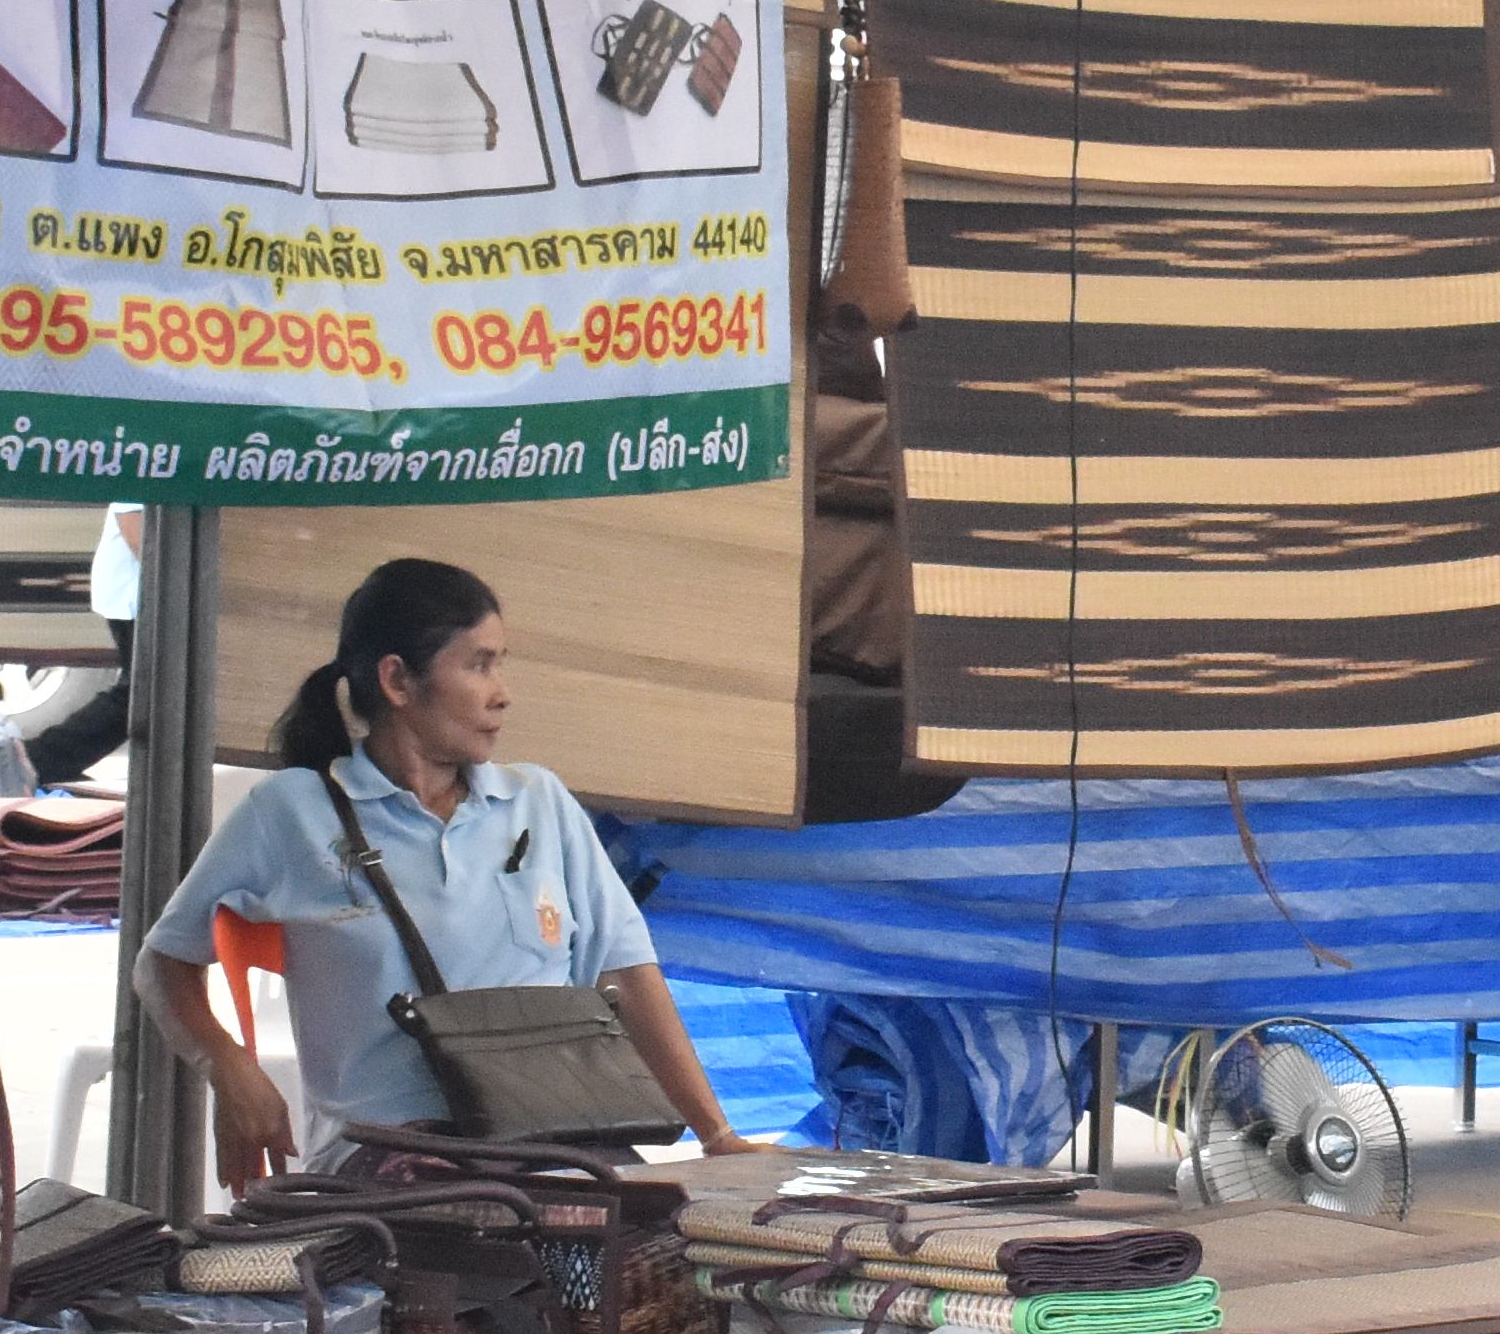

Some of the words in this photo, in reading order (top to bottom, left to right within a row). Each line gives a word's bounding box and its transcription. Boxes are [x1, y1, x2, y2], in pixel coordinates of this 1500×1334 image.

[31, 211, 162, 261] ต.แพง
[402, 227, 677, 280] จ.มหาสารคาม
[693, 216, 767, 257] 44140
[435, 293, 767, 370] 084-9569341
